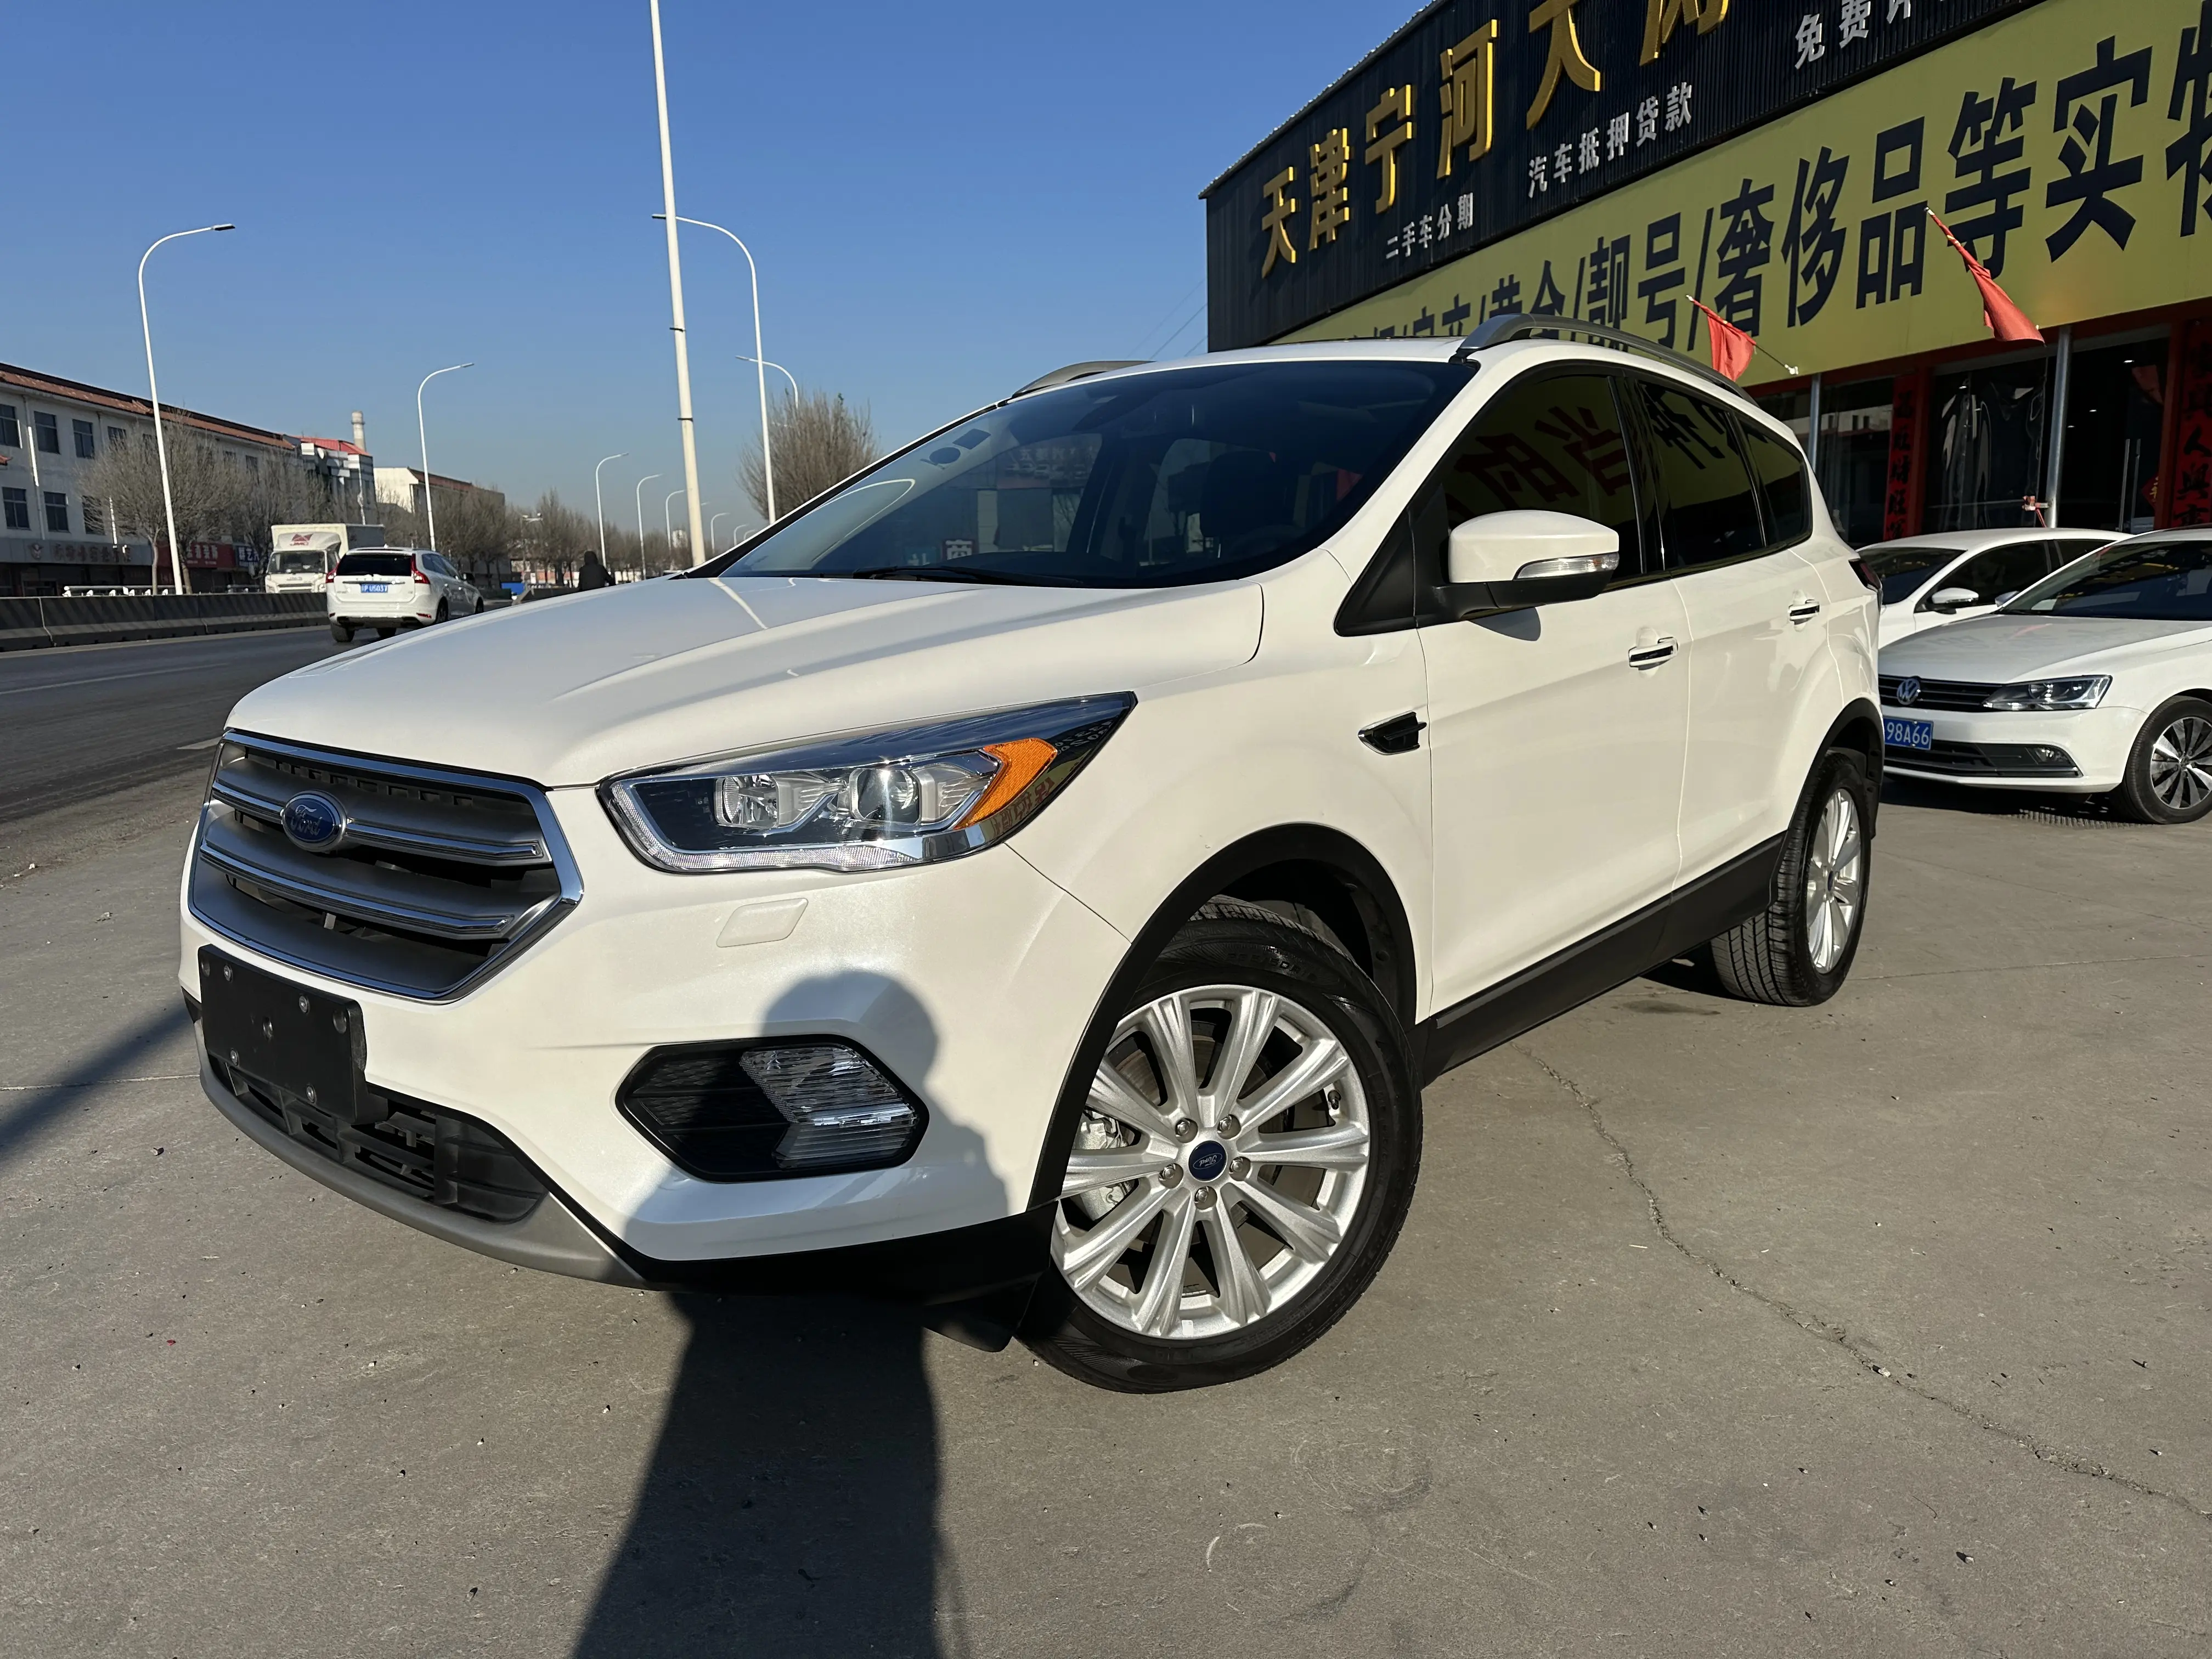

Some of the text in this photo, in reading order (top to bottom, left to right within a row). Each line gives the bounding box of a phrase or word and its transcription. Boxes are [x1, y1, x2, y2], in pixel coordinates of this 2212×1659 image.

[1528, 82, 1692, 199] 汽车抵押贷款
[1386, 192, 1474, 259] 二手车分期
[1887, 722, 1929, 745] 98A66
[291, 804, 323, 836] Ford
[1199, 1154, 1217, 1167] Ford
